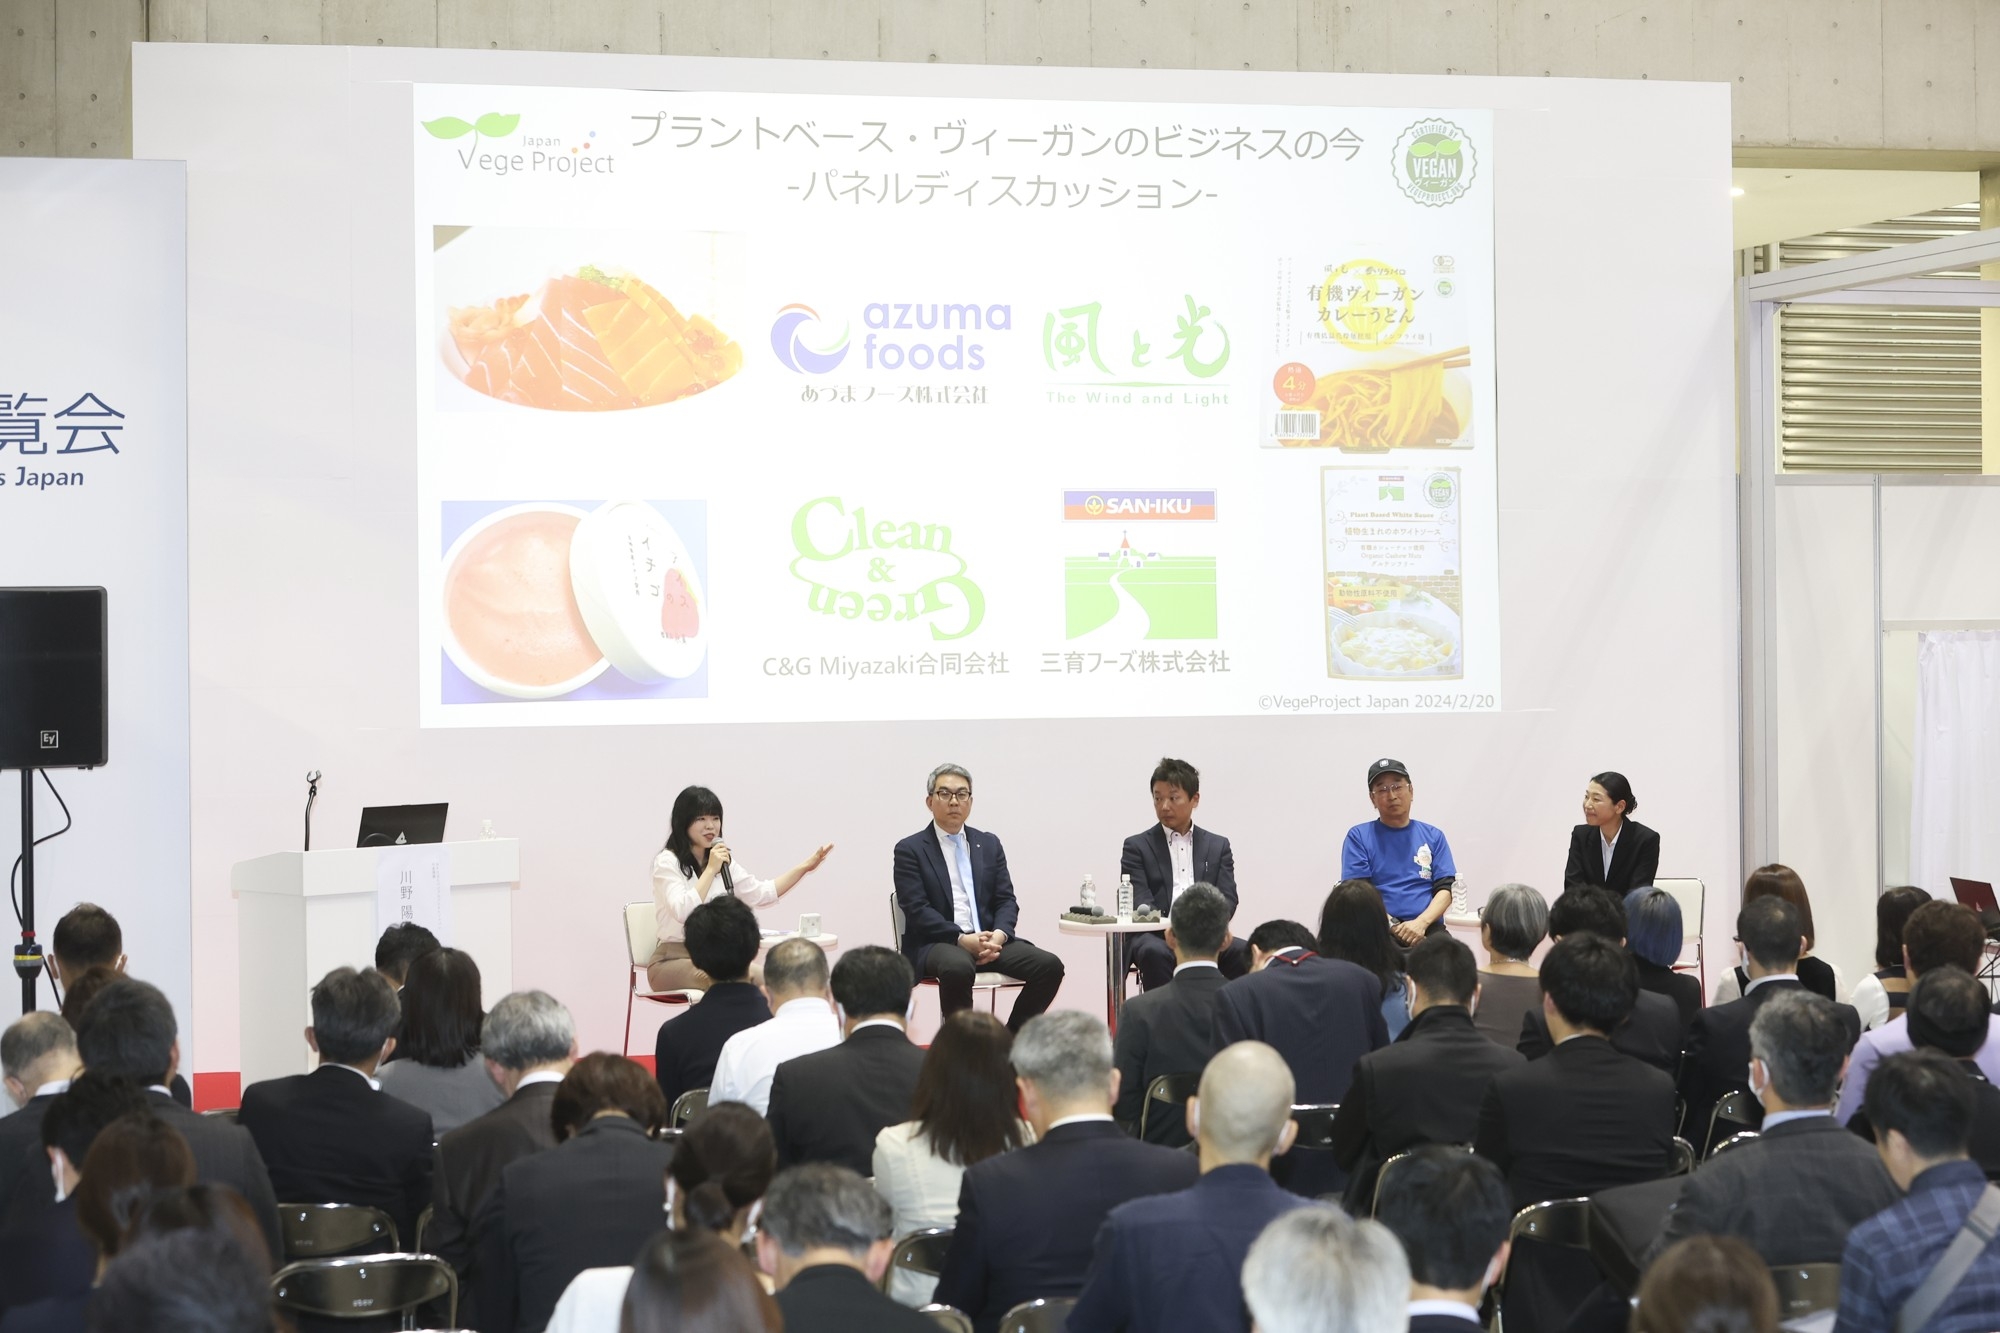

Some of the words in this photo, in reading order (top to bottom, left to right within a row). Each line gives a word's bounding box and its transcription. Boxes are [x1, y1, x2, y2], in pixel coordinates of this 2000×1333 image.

[522, 135, 561, 147] Japan
[631, 111, 1365, 161] プラントベース・ヴィーガンのビジネスの今
[458, 148, 525, 176] Vege
[531, 150, 615, 177] Project
[1412, 158, 1457, 178] VEGAN
[788, 169, 1218, 209] -パネルディスカッション-
[1414, 178, 1457, 187] ヴィーガン
[1307, 284, 1425, 302] 有機ヴィーガン
[863, 302, 1012, 331] azuma
[1317, 307, 1416, 324] カレーうどん
[1043, 294, 1230, 378] 風と光
[863, 335, 986, 372] foods
[1046, 392, 1076, 405] The
[1085, 391, 1132, 405] Wind
[1142, 392, 1173, 406] and
[1184, 392, 1230, 407] Light
[15, 466, 84, 491] Japan
[1106, 497, 1192, 515] SAN-IKU
[790, 496, 953, 562] Clean
[867, 558, 896, 583] &
[807, 574, 986, 641] Green
[763, 655, 812, 677] C&G
[821, 652, 1010, 681] Miyazaki合同会社
[1041, 650, 1231, 674] 三育フーズ株式会社
[1258, 694, 1362, 712] ©VegeProject
[1367, 694, 1409, 711] Japan
[1415, 693, 1495, 710] 2024/2/20
